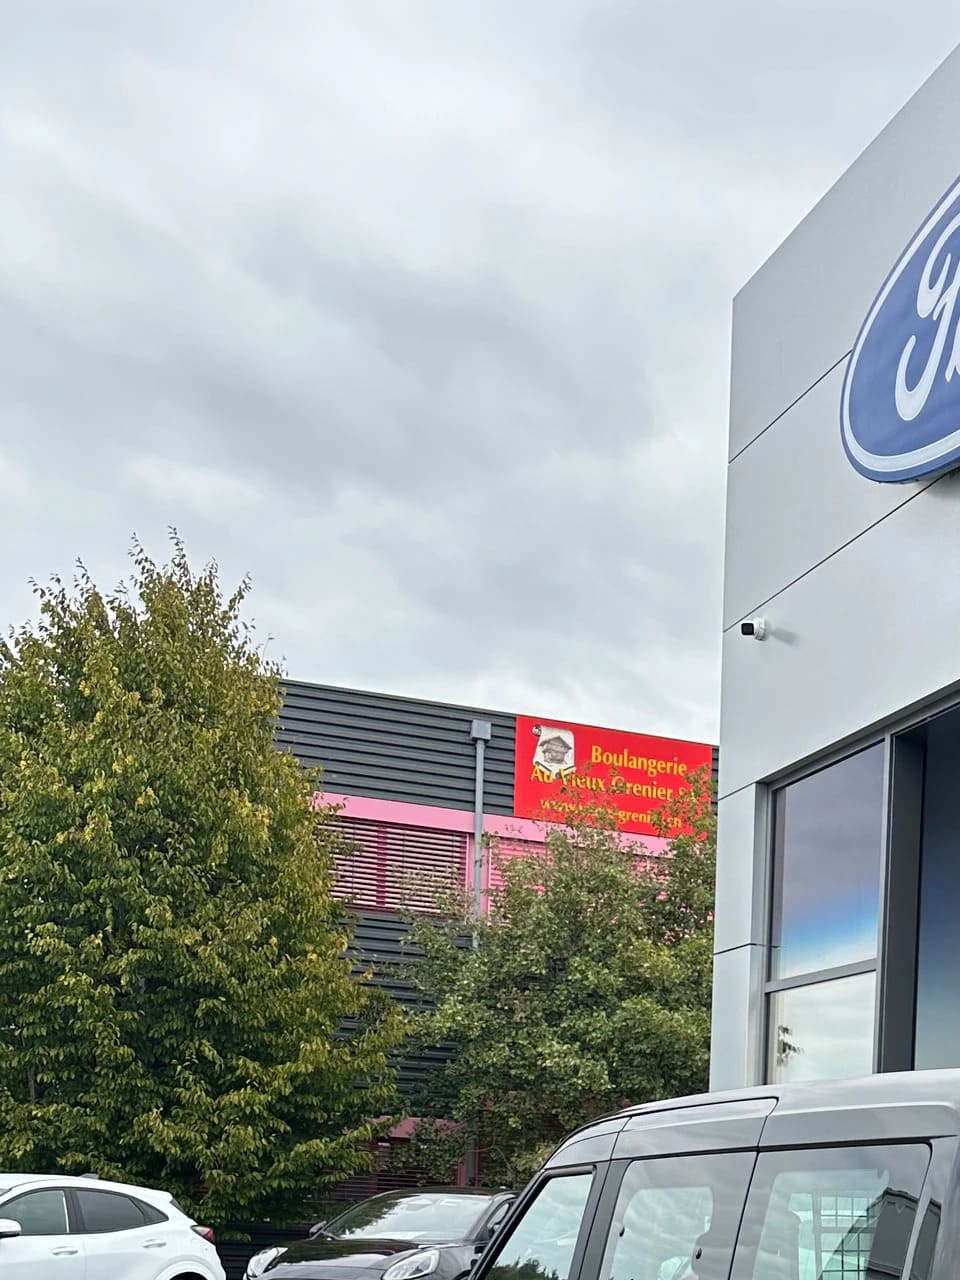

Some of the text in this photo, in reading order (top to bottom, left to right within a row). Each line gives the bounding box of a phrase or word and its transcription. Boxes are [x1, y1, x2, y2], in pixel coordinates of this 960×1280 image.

[591, 745, 687, 777] Boulangerie
[531, 765, 553, 784] Au
[560, 768, 606, 792] Vieux
[611, 776, 673, 801] Grenier
